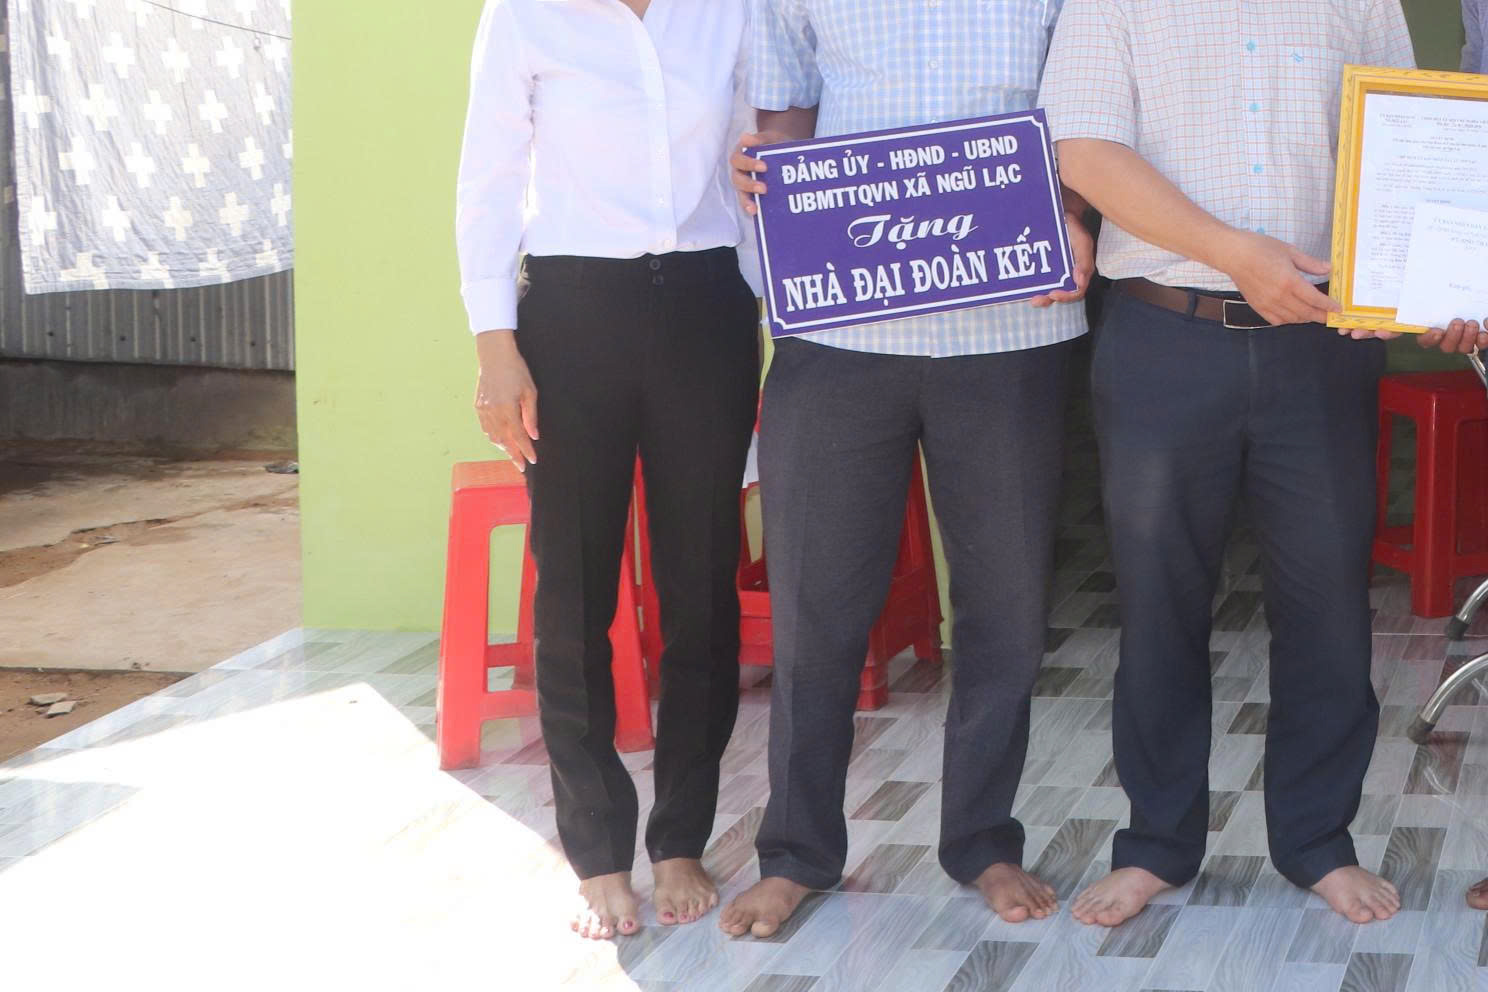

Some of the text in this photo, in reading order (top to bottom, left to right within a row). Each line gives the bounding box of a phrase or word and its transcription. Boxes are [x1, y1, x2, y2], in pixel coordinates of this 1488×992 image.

[781, 155, 839, 185] ĐẢNG
[843, 149, 870, 177] ỦY
[890, 145, 945, 171] HĐND
[963, 135, 1018, 160] UBND
[788, 164, 1022, 214] UBMTTQVN XÃ NGŨ LẠC
[847, 212, 979, 250] Tặng
[781, 226, 1053, 313] NHÀ ĐẠI ĐOÀN KẾT
